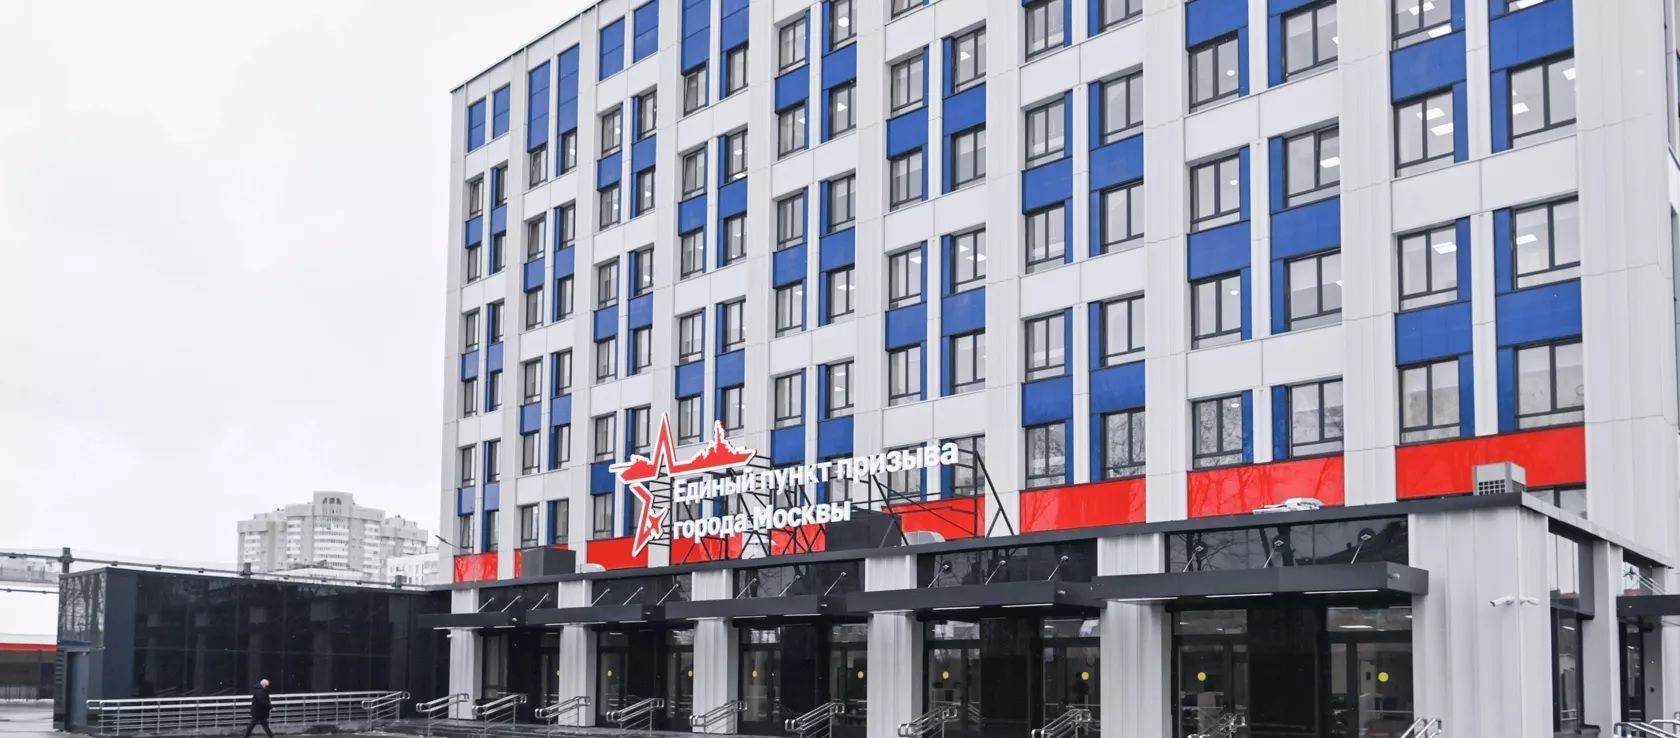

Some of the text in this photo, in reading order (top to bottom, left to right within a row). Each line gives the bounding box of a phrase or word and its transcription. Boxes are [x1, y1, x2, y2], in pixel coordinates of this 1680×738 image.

[672, 441, 960, 504] Единый пункт призыва
[672, 500, 852, 544] города Москвы
